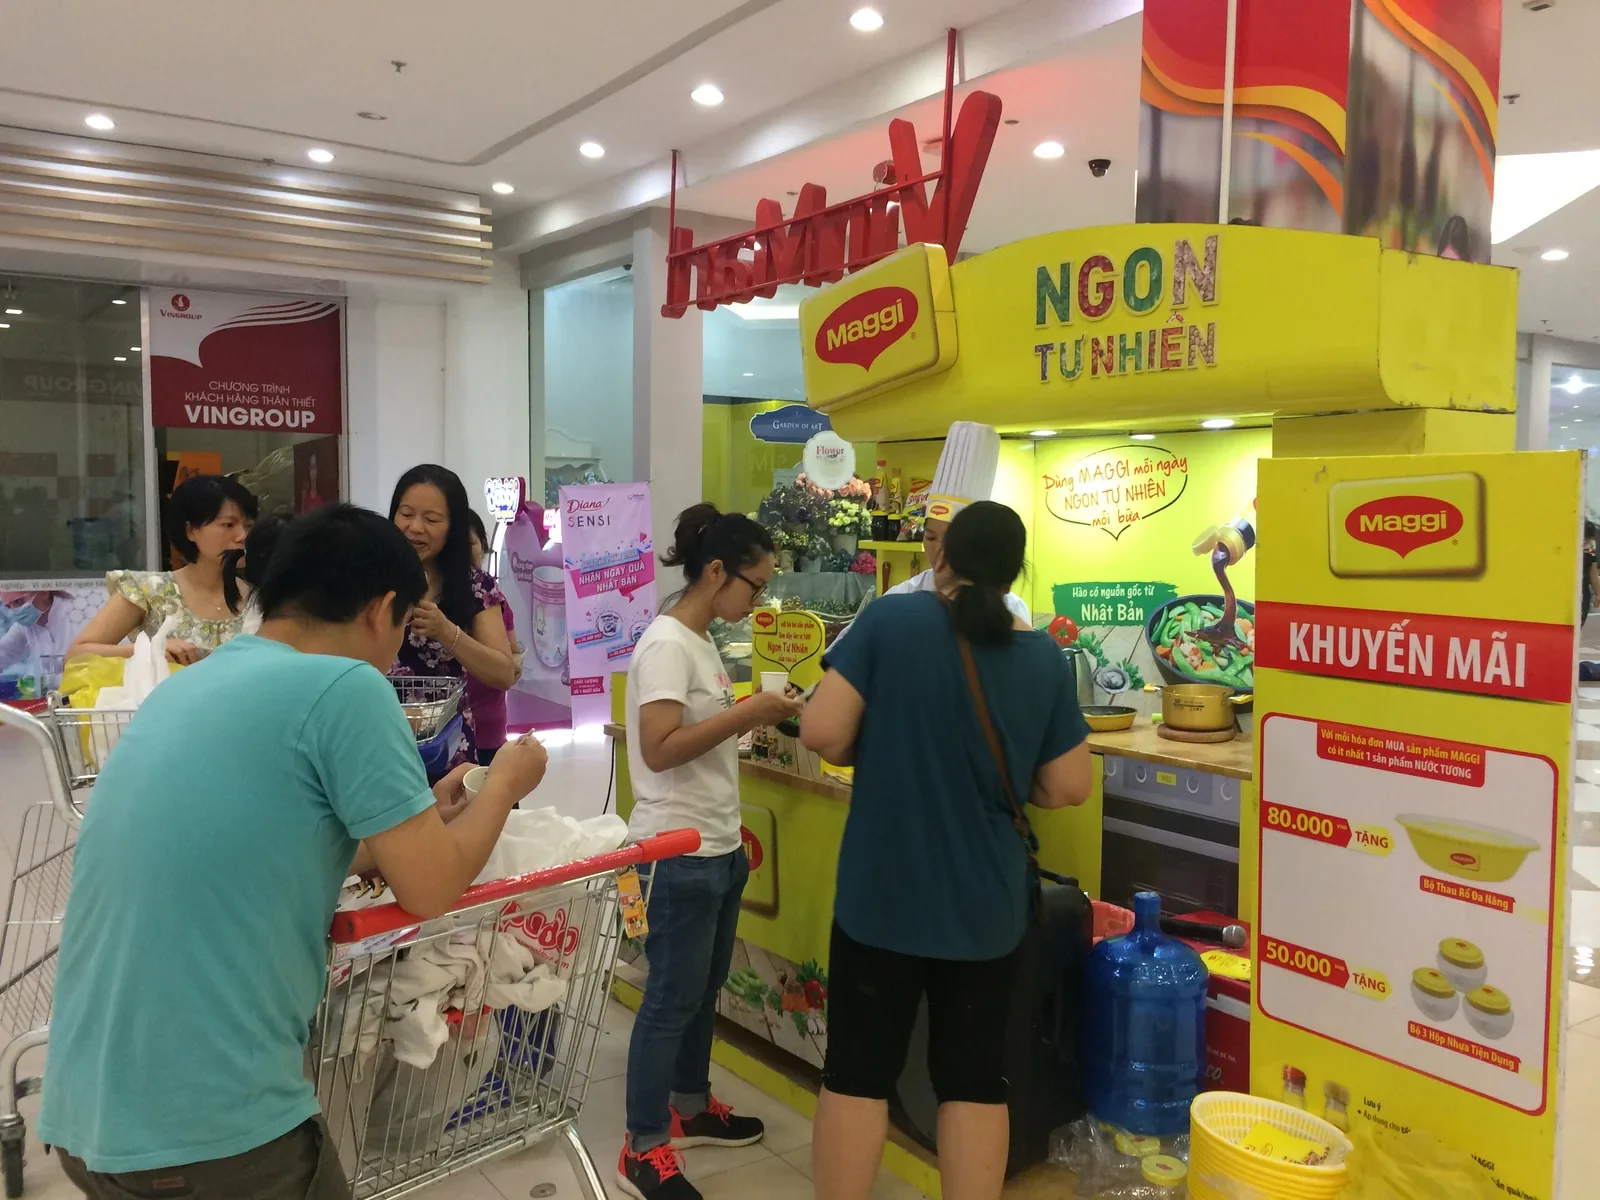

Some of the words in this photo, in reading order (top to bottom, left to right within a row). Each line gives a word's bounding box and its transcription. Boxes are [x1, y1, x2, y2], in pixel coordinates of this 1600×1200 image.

[1034, 233, 1221, 329] NGON
[160, 309, 202, 320] VINGROUP
[825, 298, 905, 351] Maggi
[1090, 312, 1218, 378] NHIÊN
[208, 380, 259, 393] CHƯƠNG
[262, 383, 290, 394] TRÌNH
[185, 391, 224, 403] KHÁCH
[226, 393, 259, 405] HÀNG
[262, 395, 290, 406] THÂN
[292, 396, 316, 408] THIẾT
[184, 404, 316, 428] VINGROUP
[816, 445, 845, 456] Flower
[1042, 474, 1074, 492] Dùng
[1078, 459, 1130, 484] MAGGI
[1134, 459, 1154, 475] mỗi
[1156, 454, 1189, 477] ngày
[566, 497, 611, 514] Diana
[1064, 491, 1100, 511] NGON
[1102, 485, 1121, 509] TỰ
[1125, 478, 1167, 502] NHIÊN
[568, 515, 611, 528] SENSI
[1092, 511, 1111, 528] mỗi
[1118, 508, 1141, 524] bữa
[1359, 509, 1448, 533] Maggi
[603, 567, 626, 580] NGAY
[1072, 586, 1088, 598] Hào
[1090, 587, 1099, 597] có
[1100, 584, 1126, 600] nguồn
[1127, 585, 1143, 599] gốc
[1145, 585, 1156, 596] từ
[1081, 604, 1113, 626] Nhật
[1117, 600, 1144, 621] Bản
[1288, 618, 1434, 677] KHUYẾN
[1446, 630, 1526, 688] MÃI
[1320, 728, 1334, 740] Với
[1335, 732, 1350, 742] mỗi
[1351, 733, 1367, 746] hóa
[1368, 736, 1384, 748] đơn
[1385, 739, 1405, 752] MUA
[1406, 743, 1422, 755] sản
[1423, 745, 1449, 759] phẩm
[1450, 750, 1481, 765] MAGGI
[1327, 745, 1337, 755] có
[1338, 746, 1344, 756] ít
[1345, 747, 1365, 760] nhất
[1366, 752, 1371, 761] 1
[1372, 753, 1387, 764] sản
[1388, 755, 1413, 769] phẩm
[1415, 759, 1439, 774] NƯỚC
[1440, 764, 1472, 779] TƯƠNG
[1267, 806, 1334, 838] 80.000
[1355, 830, 1389, 849] TẶNG
[1423, 878, 1435, 892] Bộ
[1436, 881, 1457, 896] Thau
[1471, 890, 1483, 902] Đa
[1265, 940, 1332, 977] 50.000
[1352, 972, 1386, 993] TẶNG
[1410, 1023, 1421, 1038] Bộ
[1422, 1027, 1427, 1037] 3
[1429, 1030, 1446, 1045] Hộp
[1447, 1036, 1469, 1053] Nhựa
[1471, 1044, 1490, 1060] Tiện
[1363, 1096, 1376, 1109] Lưu
[1389, 1121, 1400, 1132] cho
